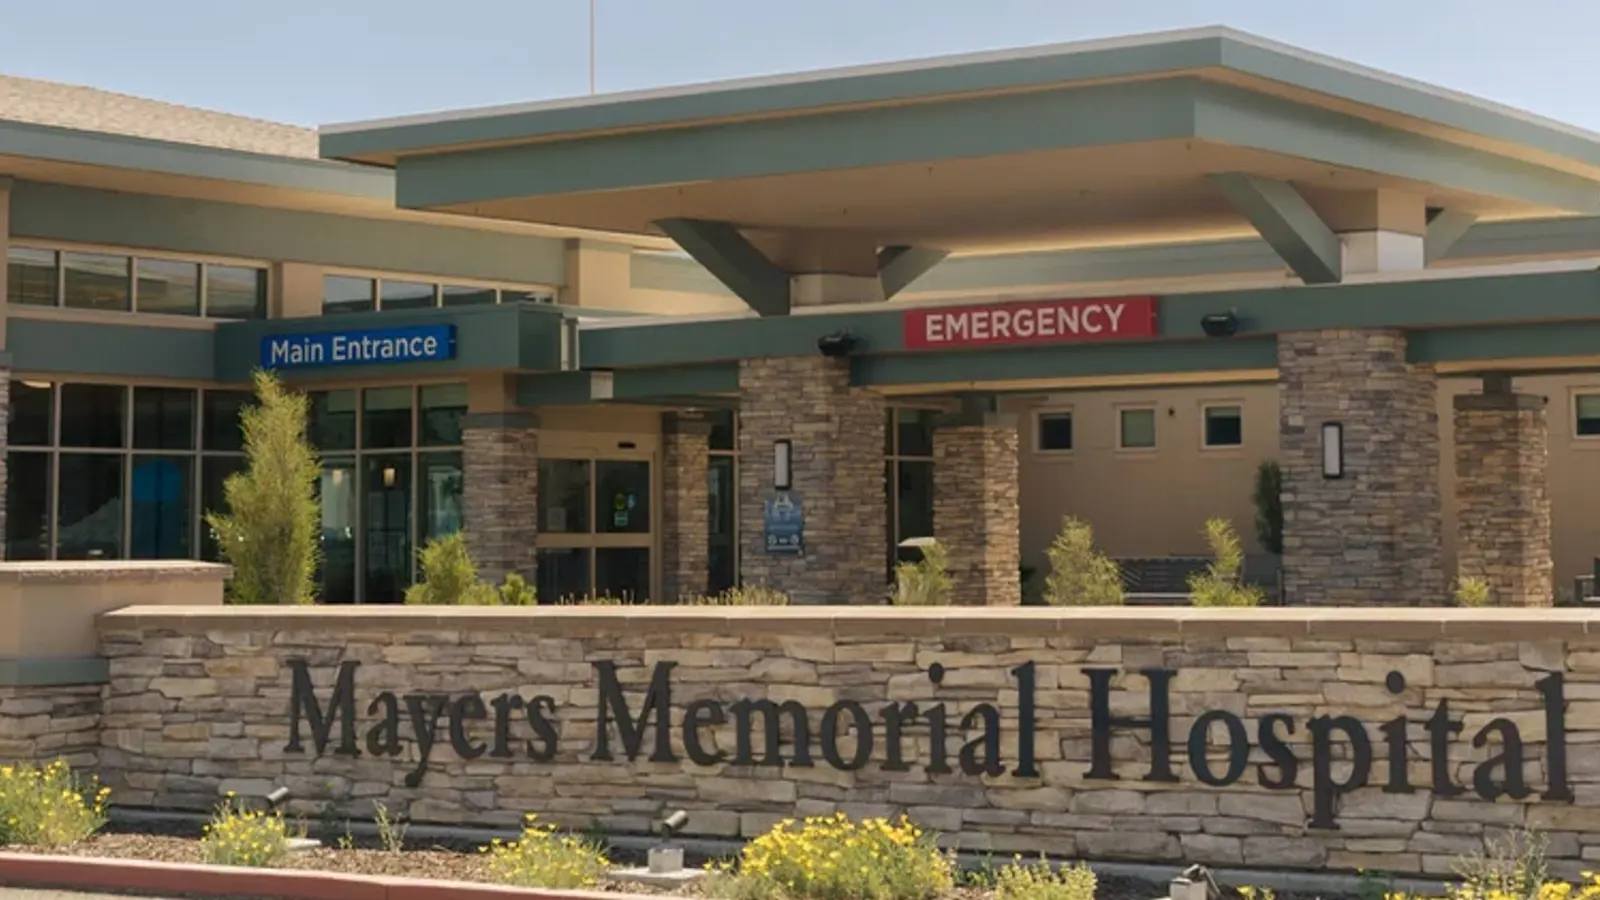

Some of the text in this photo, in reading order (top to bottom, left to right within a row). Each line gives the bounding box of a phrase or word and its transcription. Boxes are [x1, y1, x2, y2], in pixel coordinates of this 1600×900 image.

[926, 304, 1126, 342] EMERGENCY
[271, 335, 438, 364] Main Entrance
[283, 660, 1575, 830] Mayers Memorial Hospital
